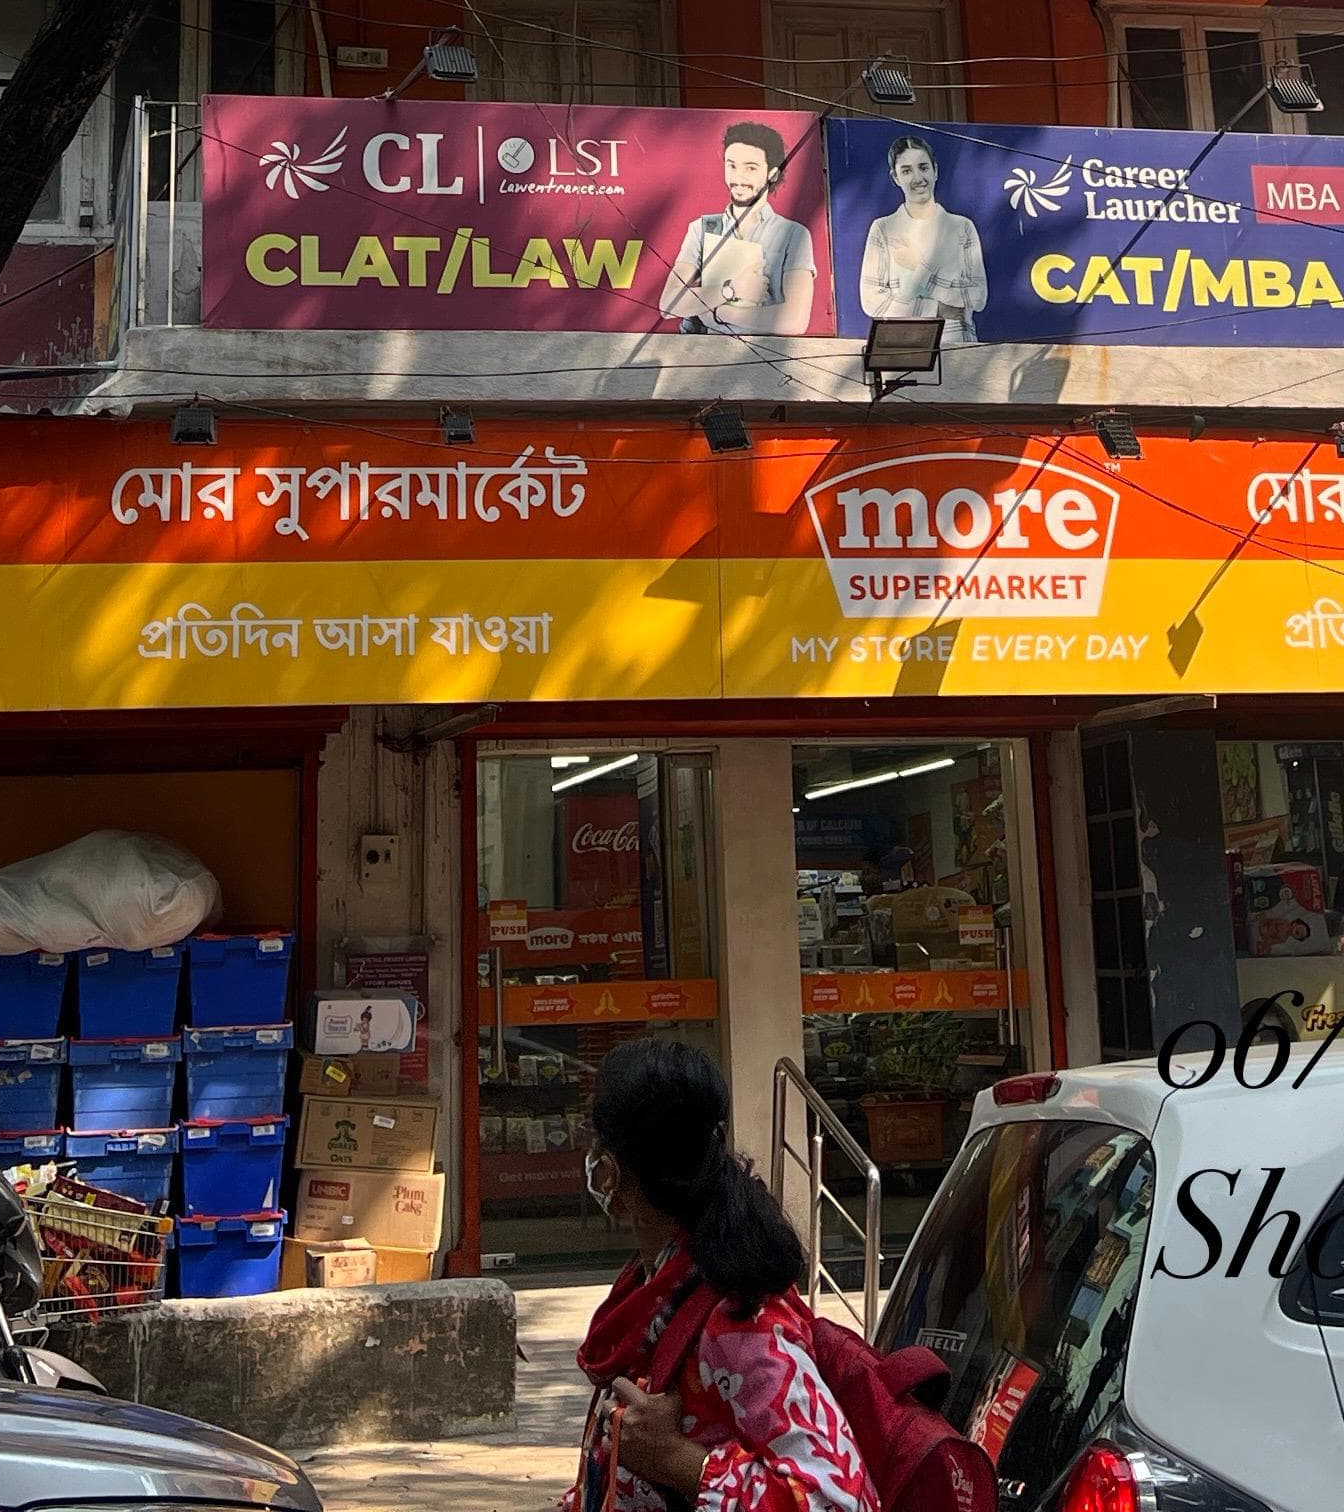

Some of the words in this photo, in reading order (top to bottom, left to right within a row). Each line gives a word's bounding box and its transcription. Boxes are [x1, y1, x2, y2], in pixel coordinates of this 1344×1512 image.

[362, 132, 463, 195] CL
[548, 139, 627, 178] LST
[498, 179, 626, 197] Lawentrance.com
[1082, 159, 1191, 192] Career
[1085, 191, 1240, 224] Launcher
[1267, 182, 1340, 212] MBA
[245, 227, 643, 295] CLAT/LAW
[112, 462, 239, 525] মোর
[256, 445, 588, 541] সুপারমার্কেট
[837, 486, 1099, 551] more
[849, 574, 1087, 601] SUPERMARKET
[138, 602, 302, 660] প্রতিদিন
[313, 612, 418, 657] আসা
[429, 610, 554, 656] যাওয়া
[792, 637, 839, 663] MY
[849, 636, 955, 663] STORE
[972, 635, 1079, 662] EVERY
[1085, 635, 1149, 661] DAY
[491, 926, 528, 935] PUSH
[530, 933, 569, 946] more
[960, 930, 993, 938] PUSH
[311, 1183, 347, 1197] UNIBIC
[393, 1186, 427, 1204] Plum
[395, 1200, 423, 1216] Cake
